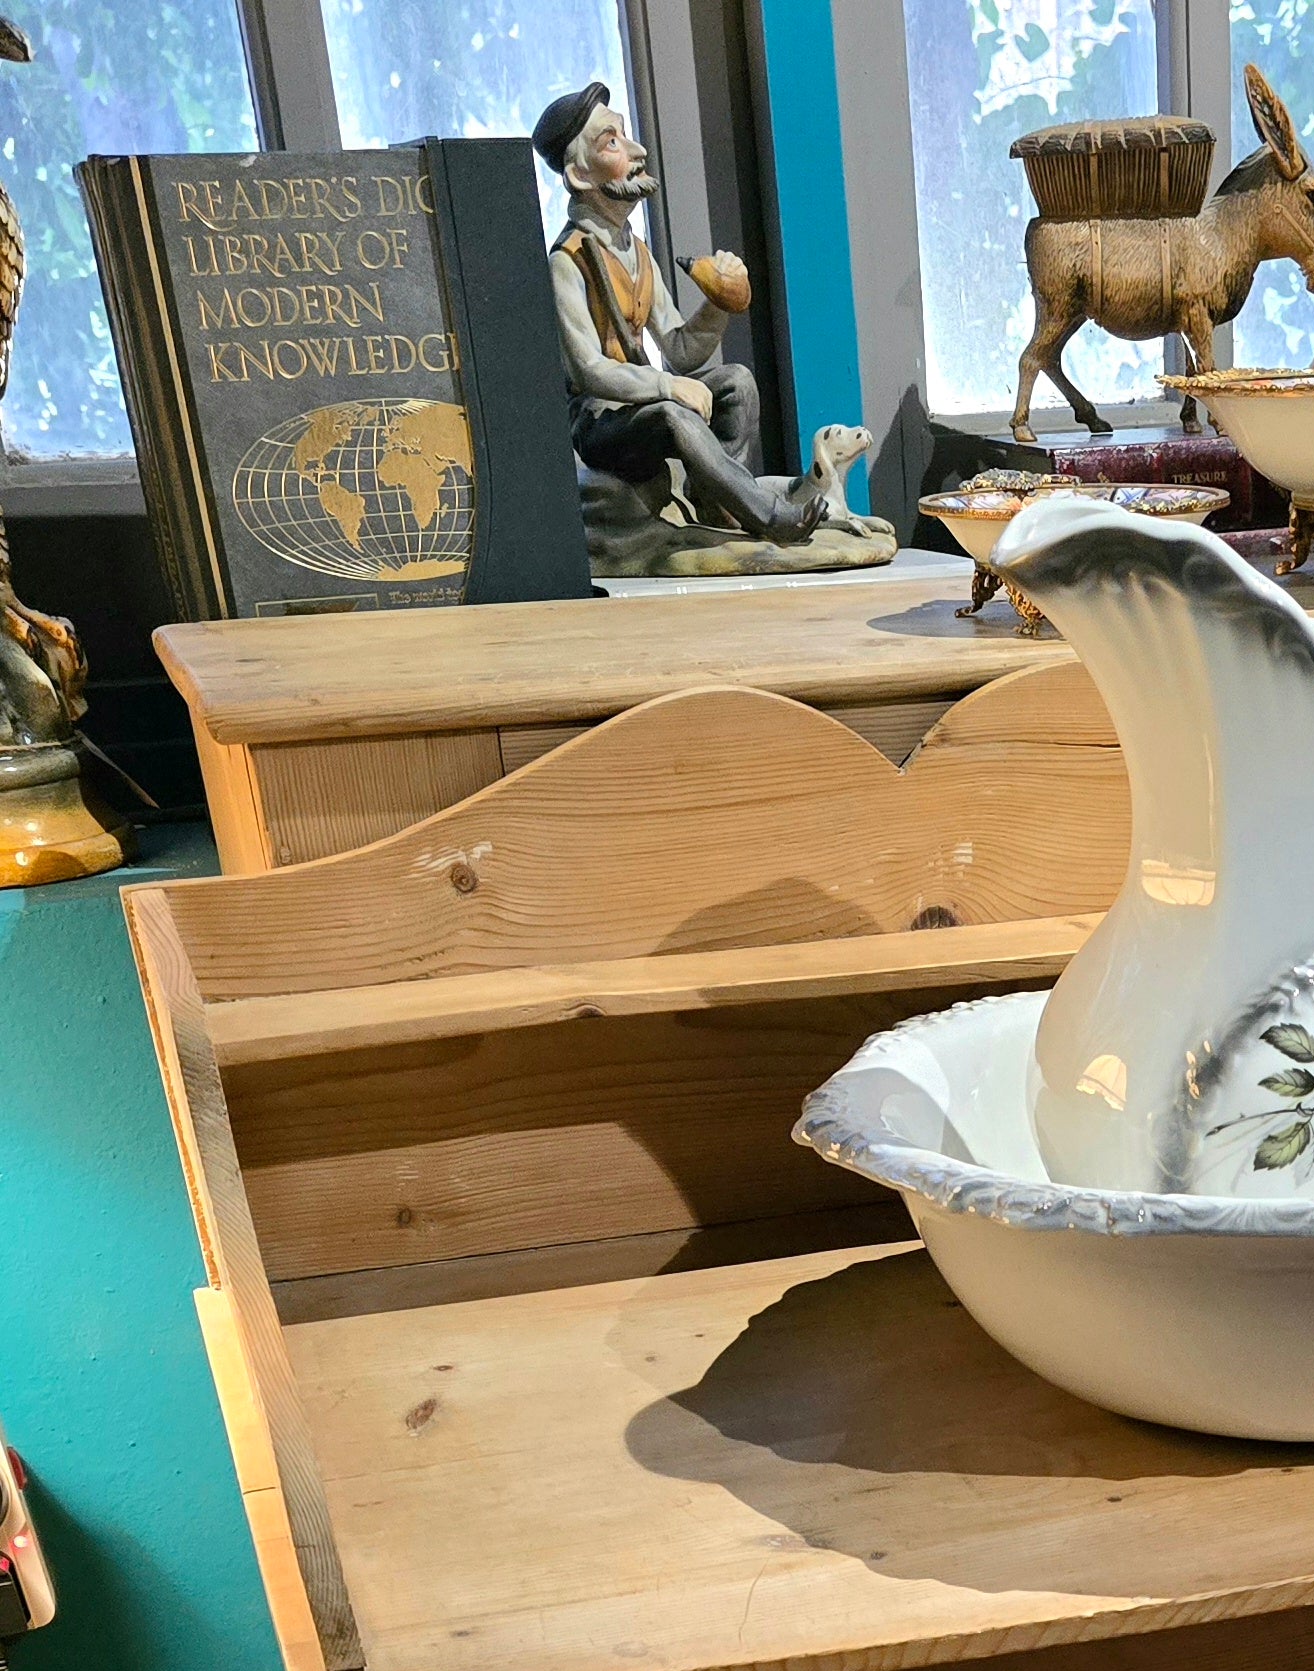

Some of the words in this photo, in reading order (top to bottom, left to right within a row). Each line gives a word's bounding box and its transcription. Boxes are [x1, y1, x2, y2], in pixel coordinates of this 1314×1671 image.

[171, 176, 362, 231] READER'S
[182, 232, 346, 279] LIBRARY
[356, 228, 409, 270] OF
[196, 281, 386, 331] MODERN
[1173, 471, 1228, 484] TREASURE
